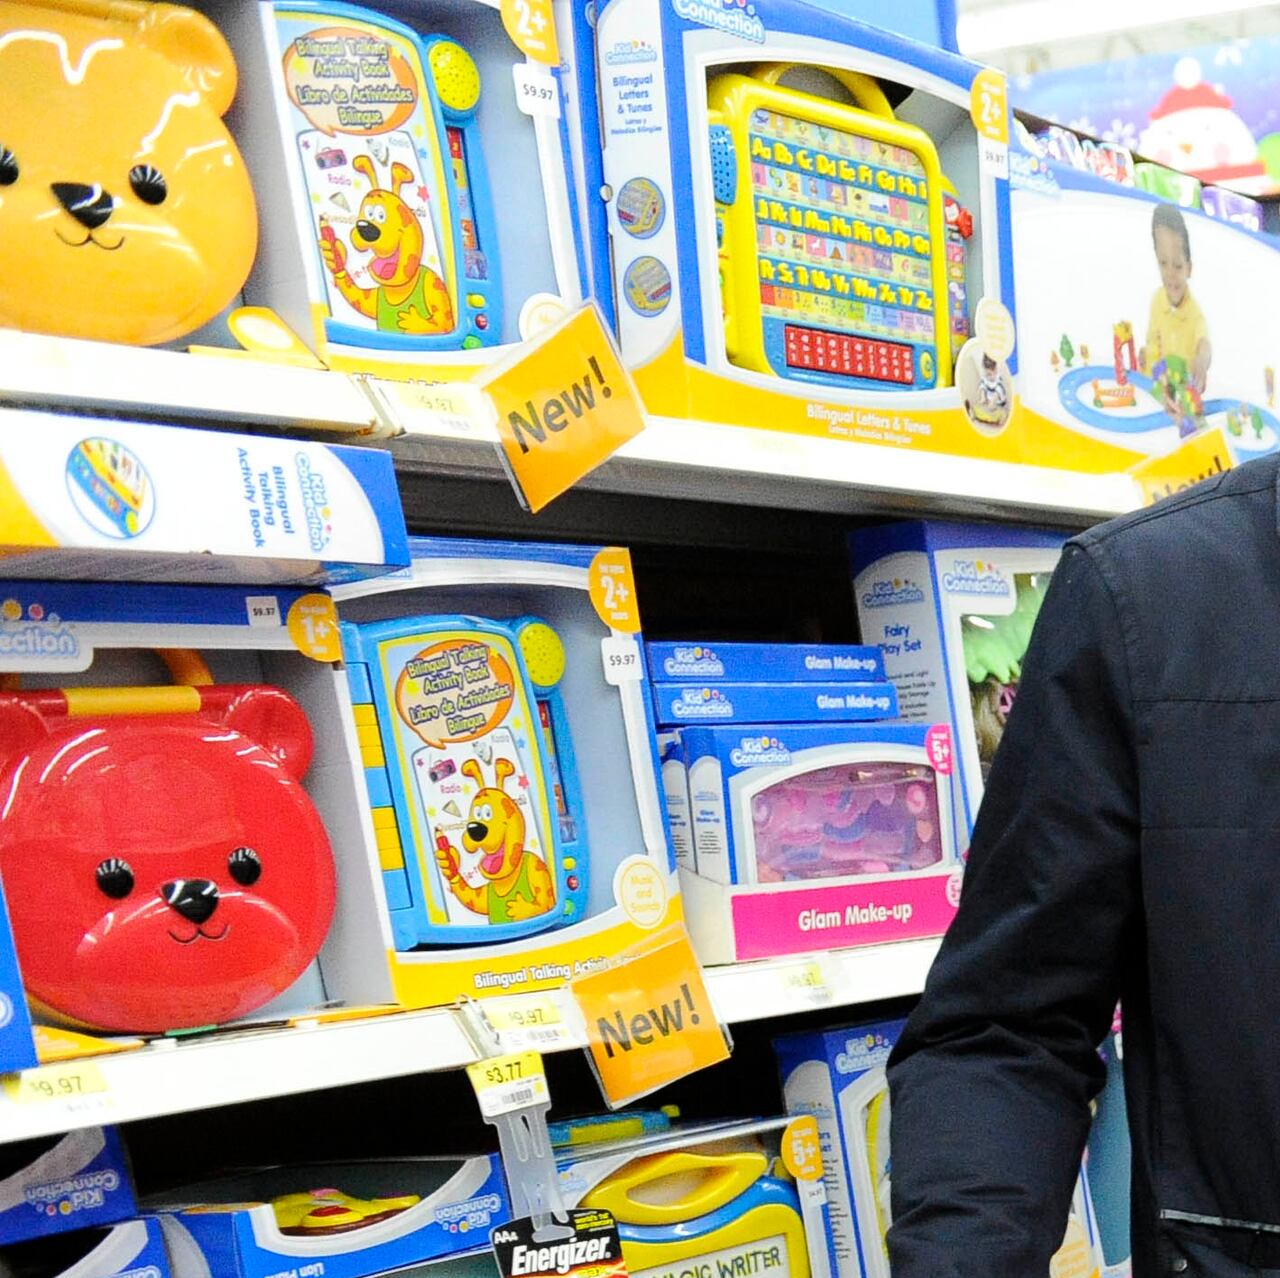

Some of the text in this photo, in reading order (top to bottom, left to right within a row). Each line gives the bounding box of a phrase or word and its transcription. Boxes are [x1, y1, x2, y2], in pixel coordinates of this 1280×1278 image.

[679, 0, 763, 40] Connection
[522, 83, 553, 101] $9.97
[613, 75, 653, 88] Bilingual
[619, 90, 649, 101] Letters
[627, 102, 653, 113] Tunes
[508, 355, 612, 454] New!
[806, 403, 853, 425] Bilingual
[857, 410, 890, 428] Letters
[903, 420, 932, 435] Tunes
[237, 447, 267, 548] Activity Book
[258, 471, 275, 526] Talking
[271, 466, 295, 534] Bilingual
[311, 473, 328, 508] Kid
[295, 452, 326, 551] Connection
[954, 560, 977, 576] Kid
[601, 575, 630, 609] 2+
[944, 575, 1009, 595] Connection
[864, 591, 924, 607] Connection
[884, 624, 910, 638] Fairy
[674, 648, 696, 661] Kid
[903, 639, 922, 652] Set
[609, 654, 636, 667] $9.97
[665, 660, 724, 676] Connection
[805, 655, 877, 673] Glam Make-up
[422, 664, 490, 696] Activity Book
[682, 689, 704, 703] Kid
[816, 694, 890, 712] Glam Make-up
[673, 700, 733, 717] Connection
[742, 738, 763, 752] Kid
[733, 750, 791, 766] Connection
[798, 902, 913, 931] Glam Make-up
[474, 961, 571, 989] Bilingual Talking
[596, 983, 701, 1059] New!
[486, 1061, 523, 1084] $3.77
[24, 1169, 120, 1200] Connection
[72, 1188, 103, 1211] Kid
[434, 1193, 501, 1223] Connection
[464, 1209, 490, 1232] Kid
[511, 1236, 611, 1277] Energizer
[299, 1261, 325, 1278] Lion
